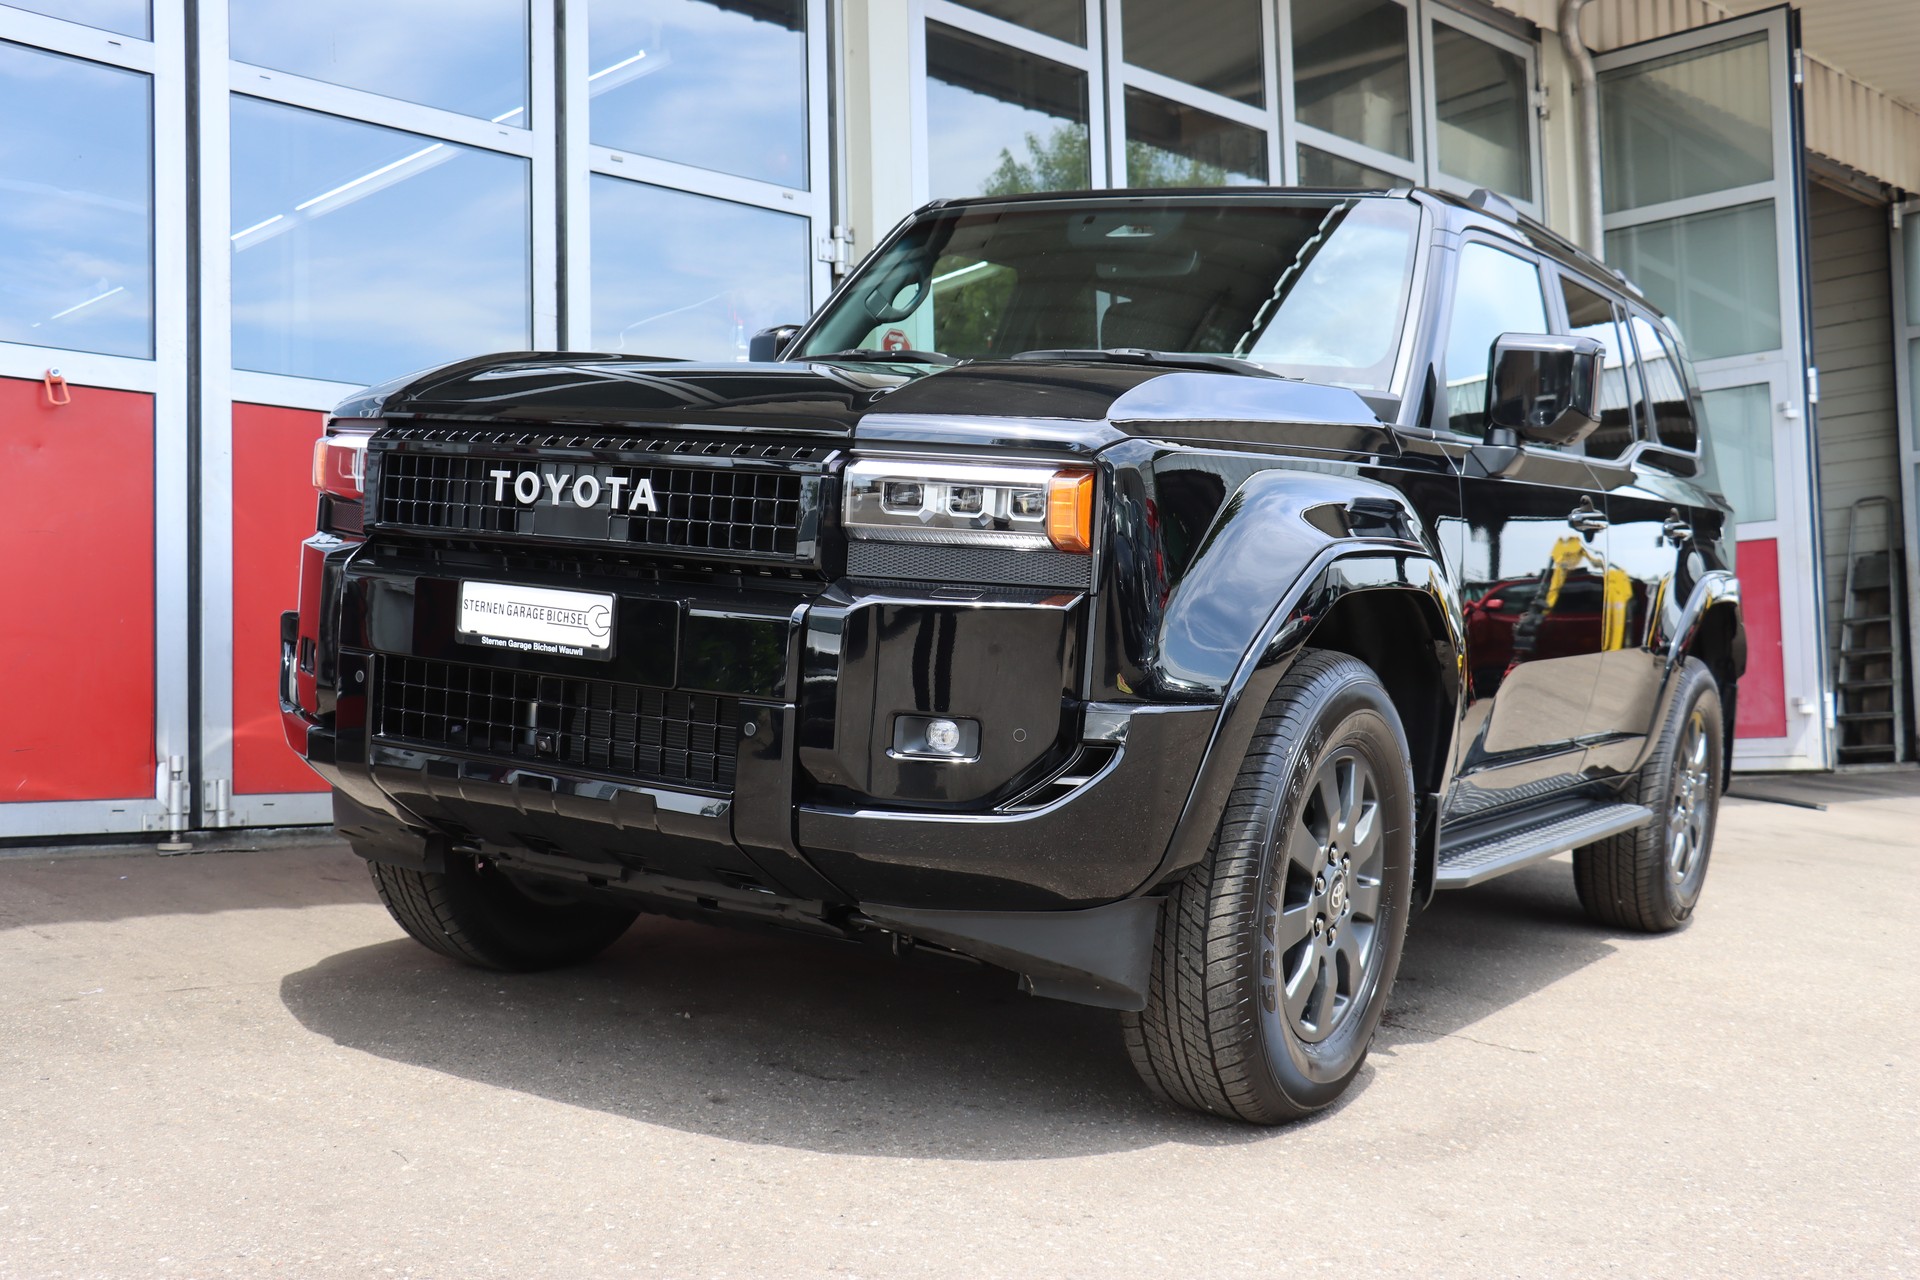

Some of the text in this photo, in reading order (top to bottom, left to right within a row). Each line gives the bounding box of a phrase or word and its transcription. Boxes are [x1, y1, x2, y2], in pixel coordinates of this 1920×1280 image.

[490, 470, 660, 512] TOYOTA
[464, 598, 589, 626] STERNEN GARAGE BICHSEL
[481, 636, 584, 656] Sternen Garage Bichsel Wauwil
